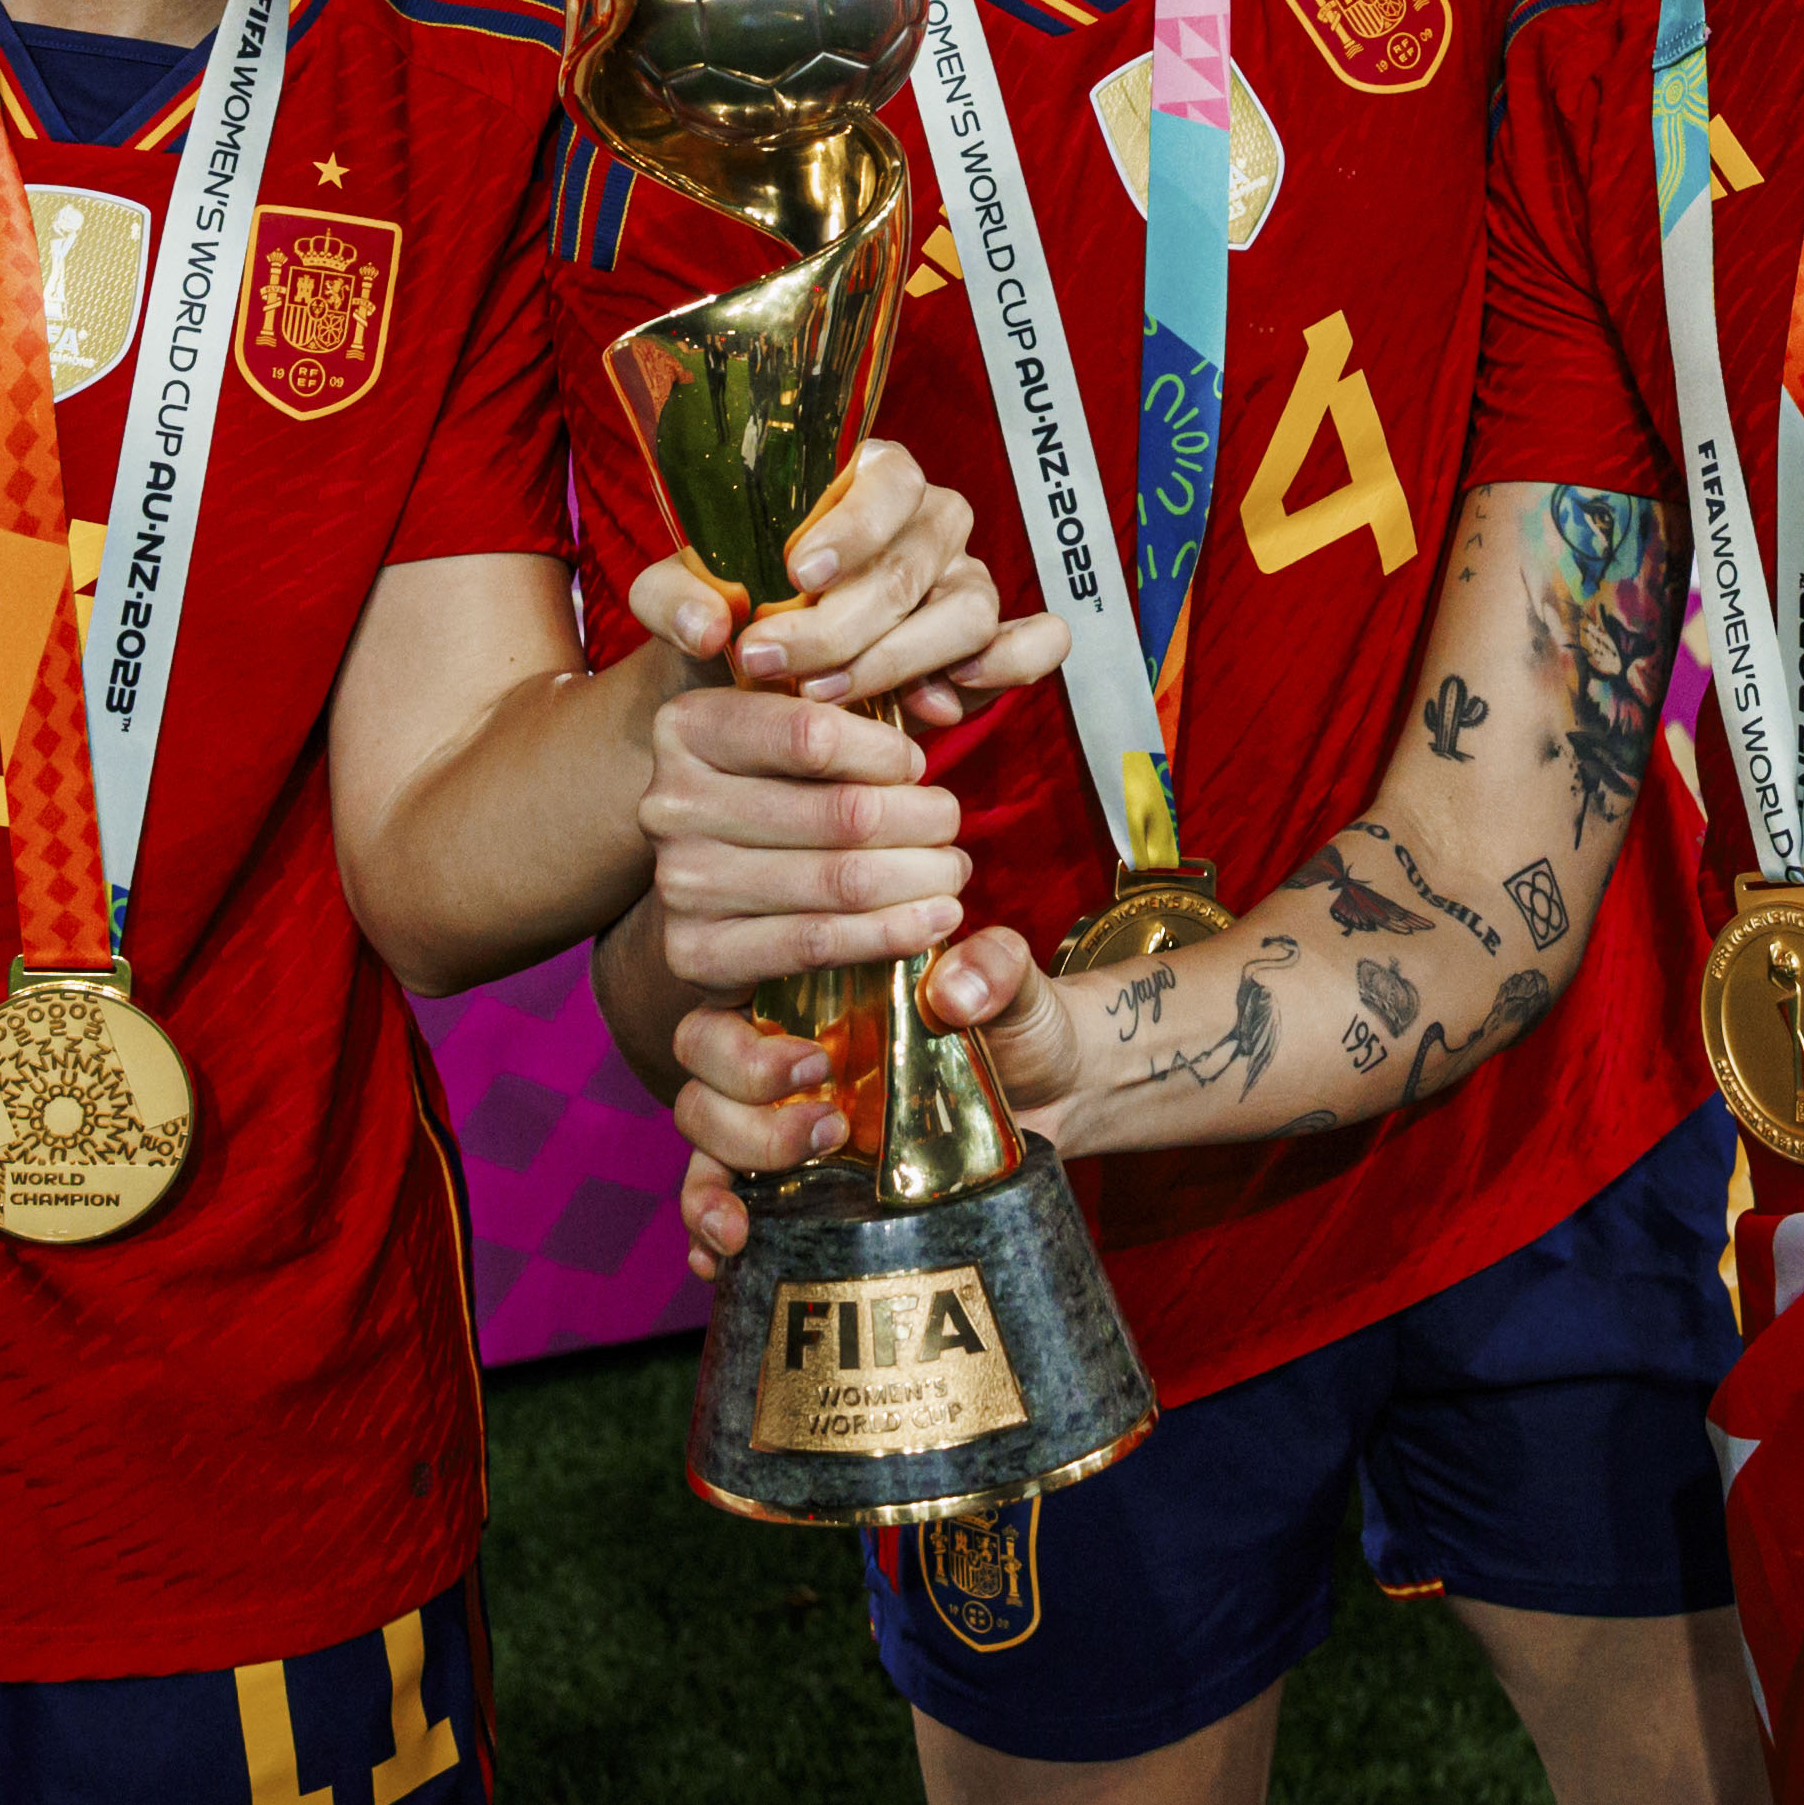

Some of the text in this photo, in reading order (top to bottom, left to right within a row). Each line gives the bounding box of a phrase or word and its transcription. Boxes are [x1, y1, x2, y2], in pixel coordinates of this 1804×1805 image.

[196, 65, 260, 234] WOMEN'S
[960, 139, 1016, 274] WORLD
[997, 277, 1038, 351] CUP
[168, 240, 220, 374] WORLD
[271, 367, 285, 380] 19
[329, 376, 344, 388] 09
[154, 379, 191, 457] CUP
[1239, 309, 1419, 576] 4
[1698, 439, 1795, 860] FIFA WOMEN'S WORLD
[1341, 1013, 1389, 1075] 1957
[9, 1192, 120, 1207] CHAMPION
[10, 1171, 85, 1186] WORLD
[808, 1401, 963, 1436] WORLD CUP
[817, 1377, 949, 1409] WOMEN'S
